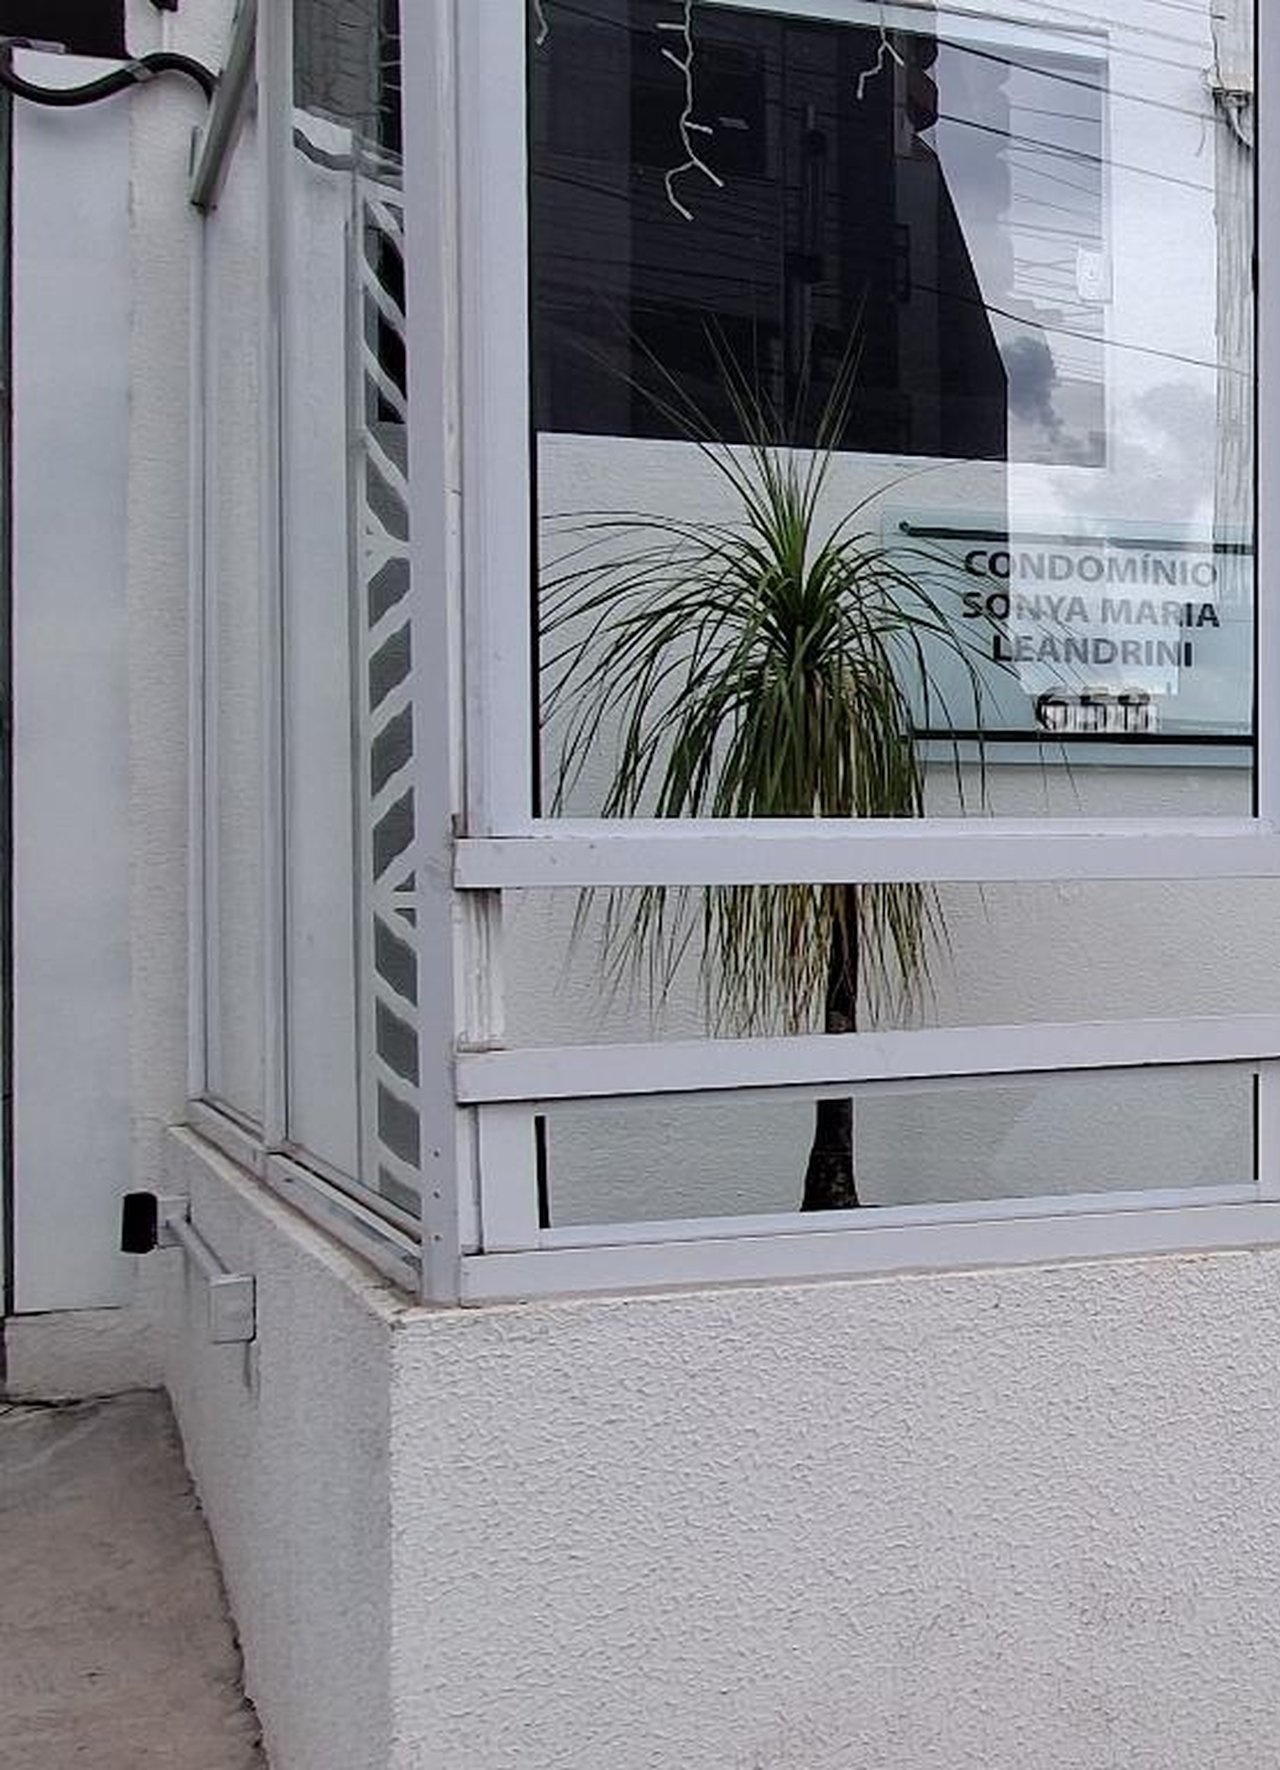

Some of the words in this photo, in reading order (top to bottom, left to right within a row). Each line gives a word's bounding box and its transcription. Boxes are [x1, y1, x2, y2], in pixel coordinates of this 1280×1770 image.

[963, 550, 1218, 588] CONDOMÍNIO
[962, 591, 1088, 624] SONYA
[1101, 598, 1220, 628] MARIA
[992, 635, 1193, 668] LEANDRINI
